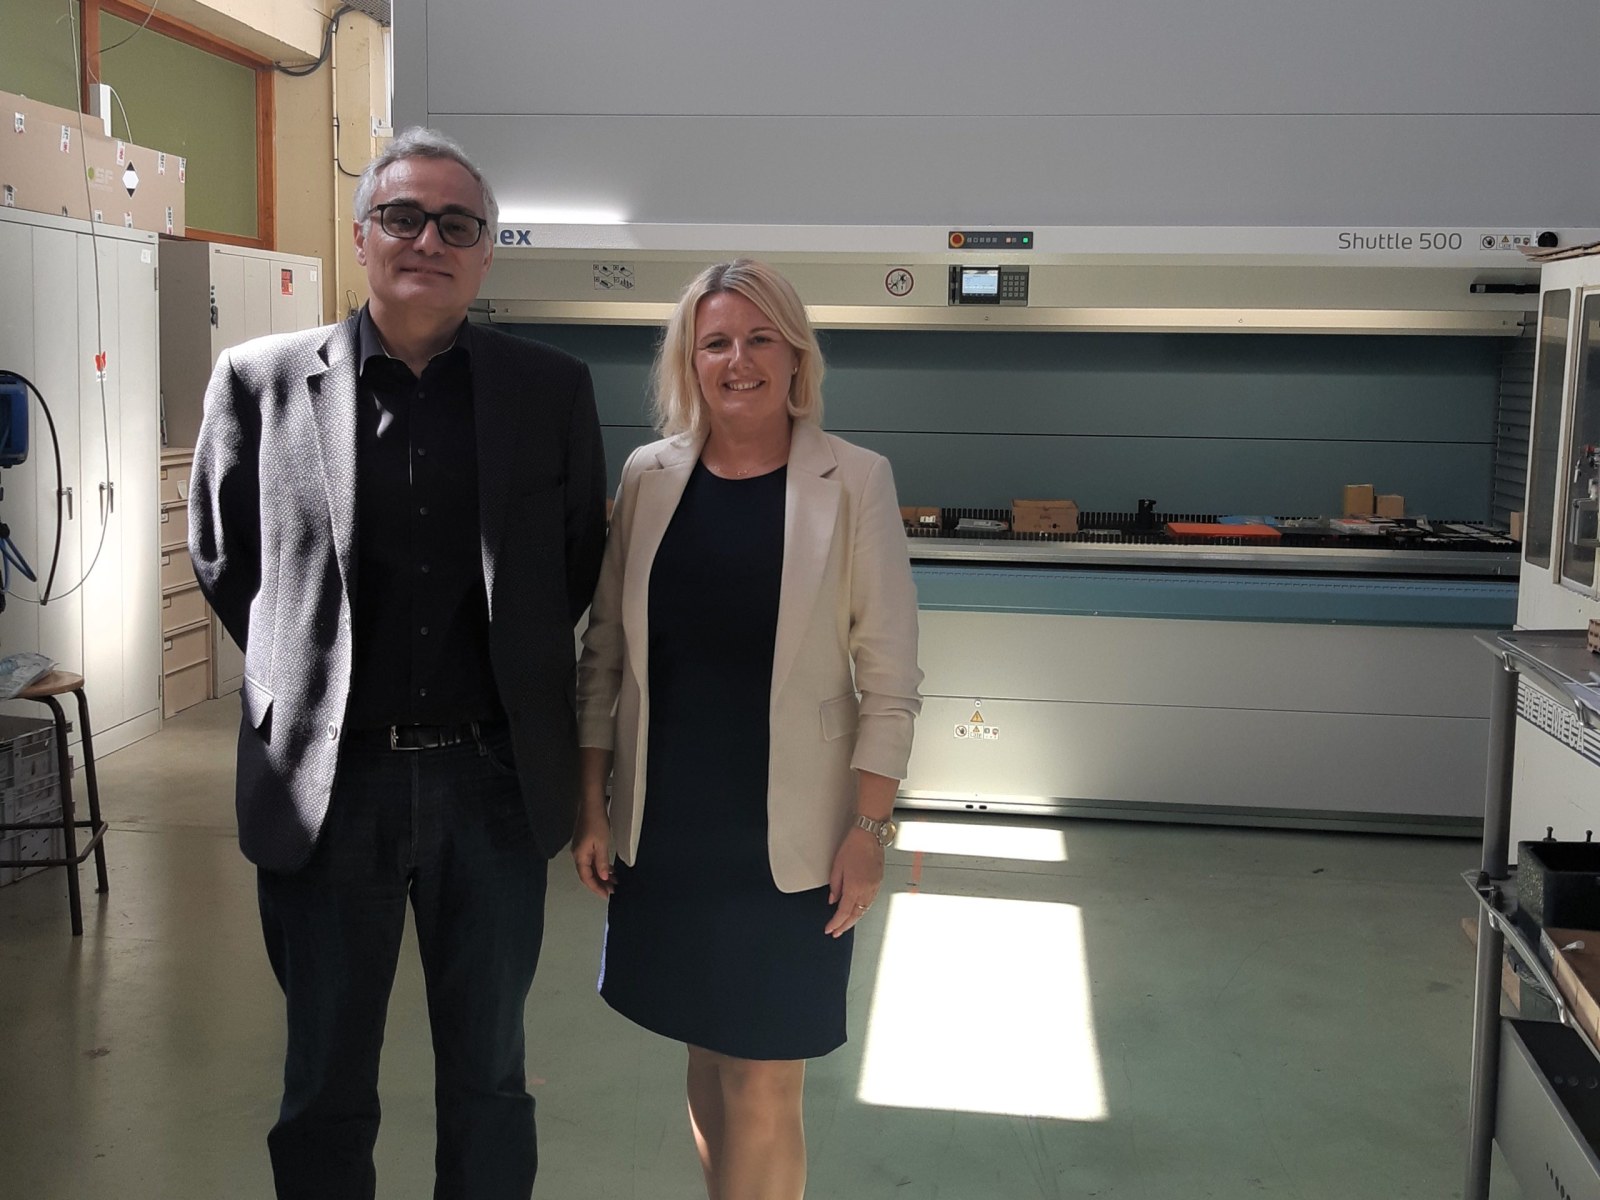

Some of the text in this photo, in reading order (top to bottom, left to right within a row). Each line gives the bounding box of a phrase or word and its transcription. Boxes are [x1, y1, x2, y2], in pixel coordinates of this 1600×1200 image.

[494, 228, 532, 246] ex
[1338, 232, 1463, 250] Shuttle 500
